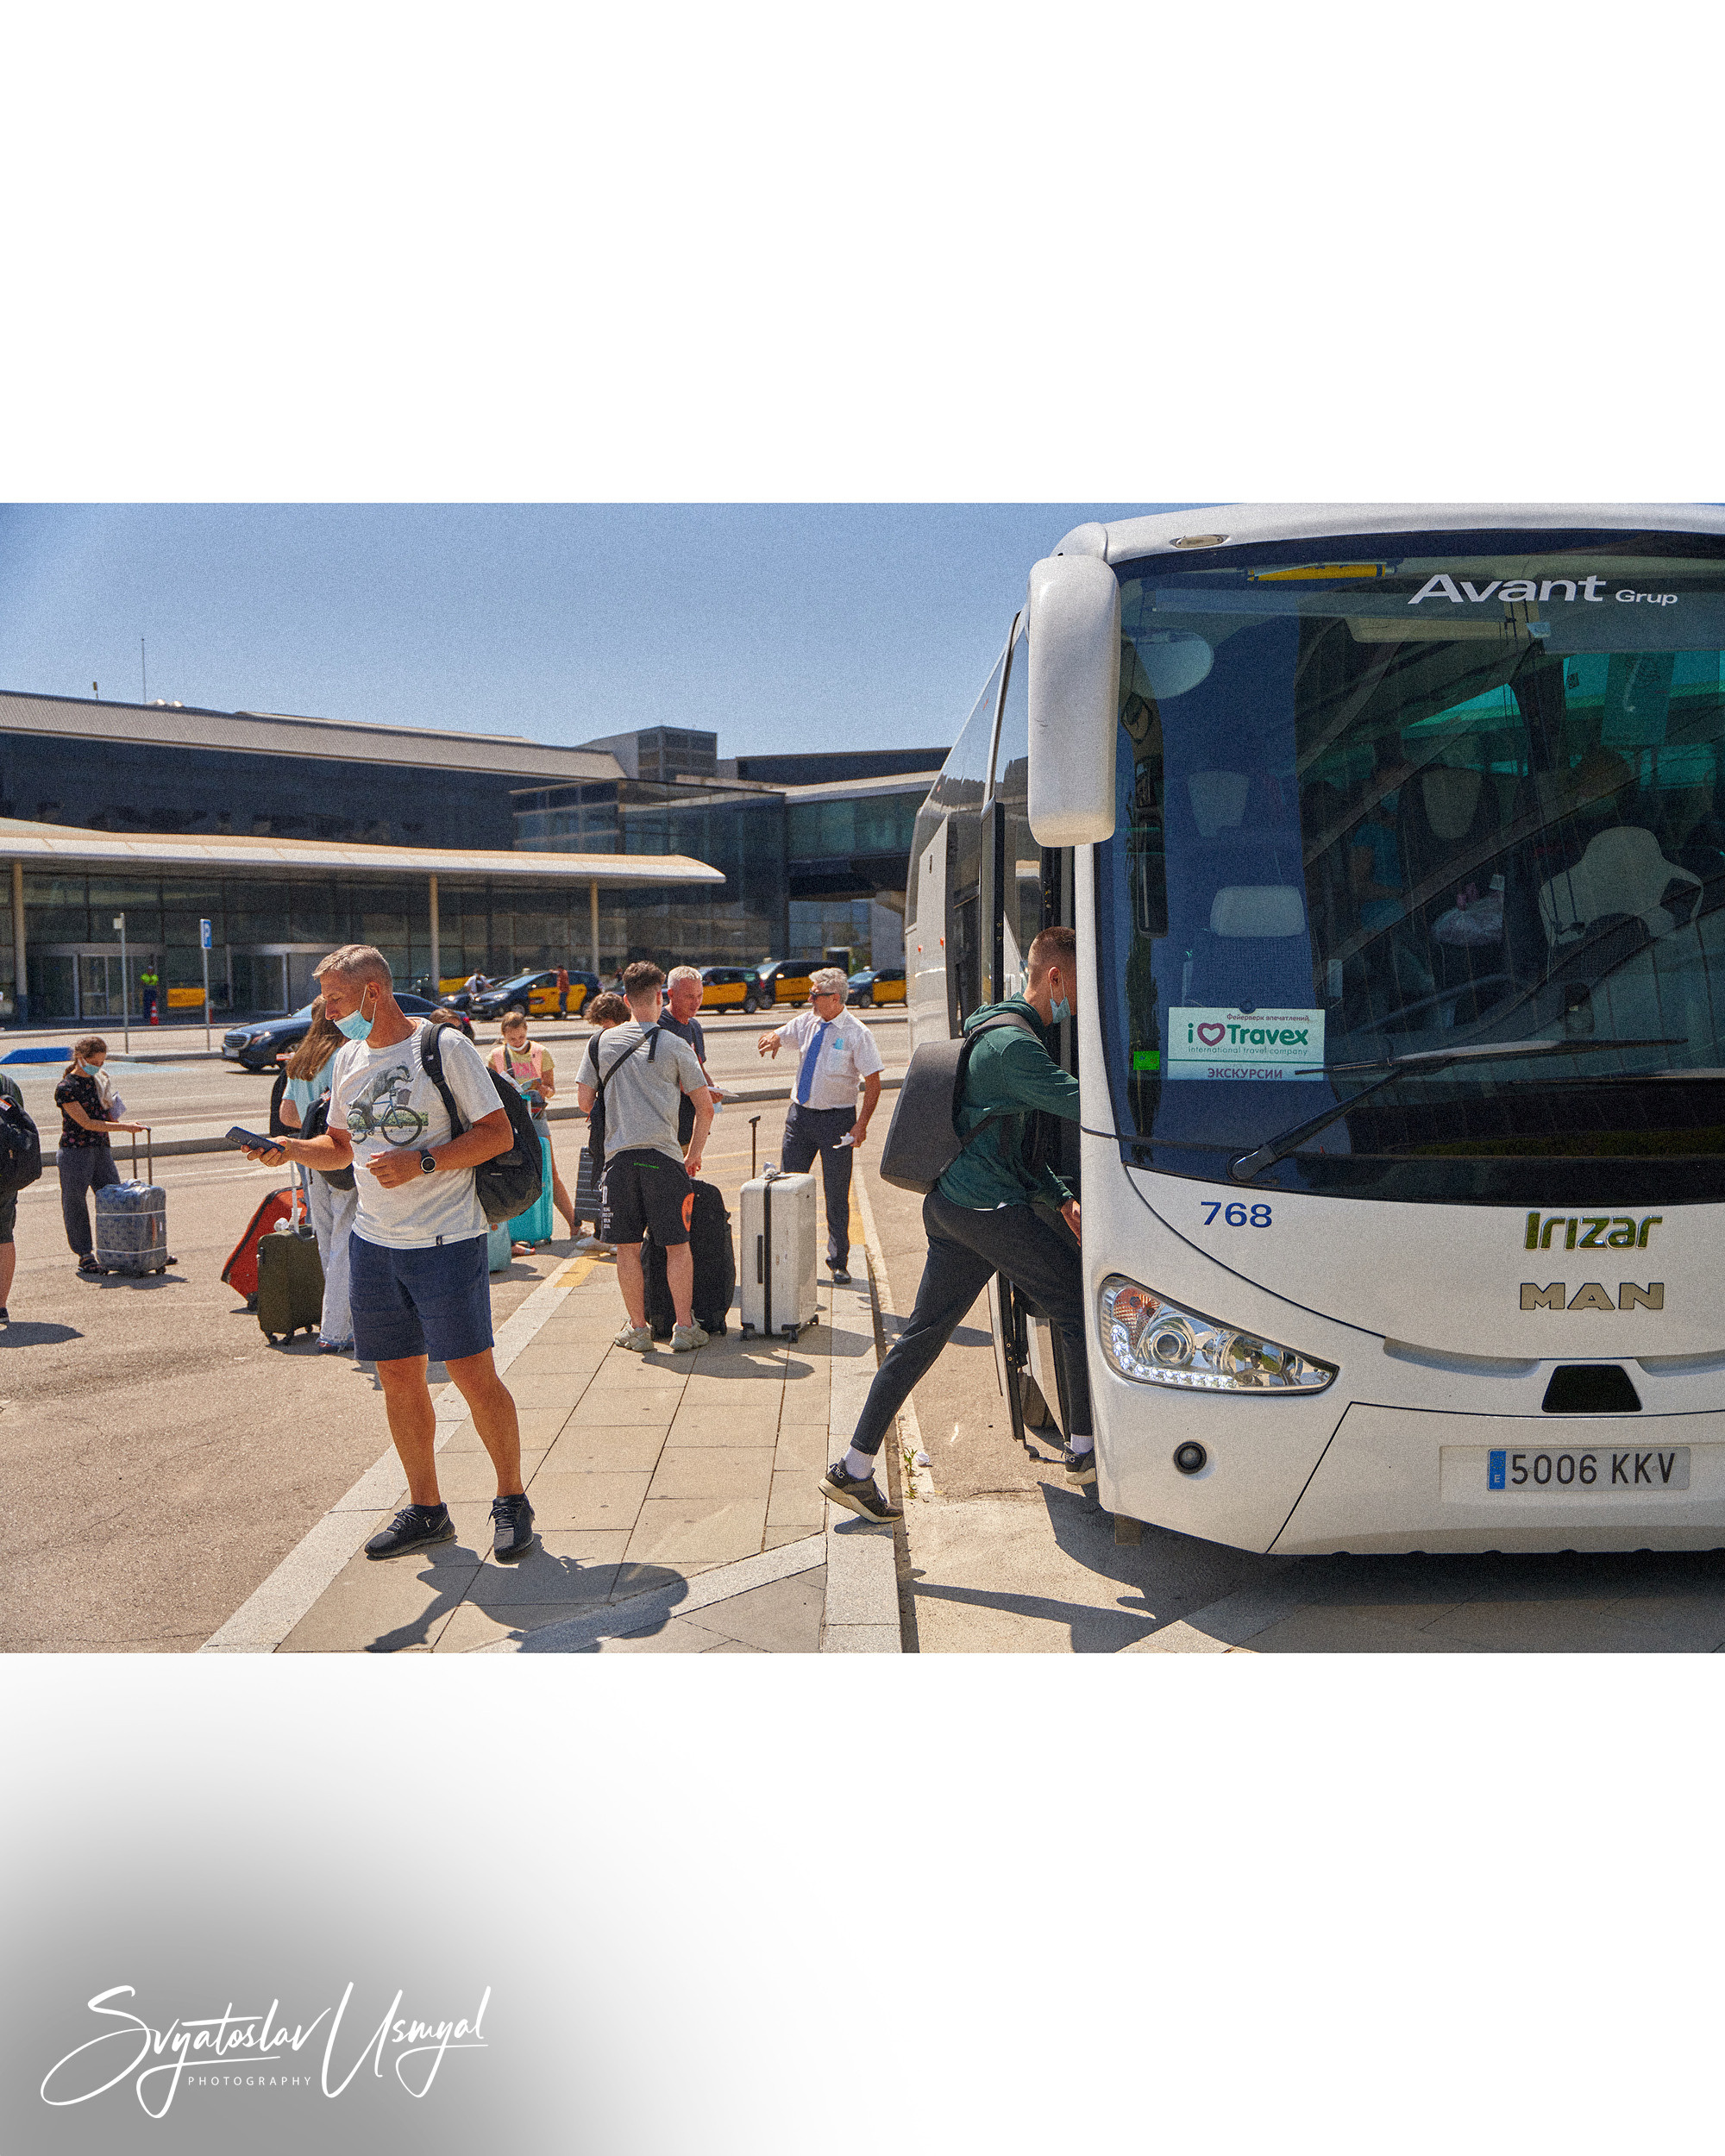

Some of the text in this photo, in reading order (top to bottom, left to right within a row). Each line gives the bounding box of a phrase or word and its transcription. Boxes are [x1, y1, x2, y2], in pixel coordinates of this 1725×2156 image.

[1408, 573, 1678, 606] Avant Grup
[1226, 1012, 1264, 1022] Фейерверк
[1188, 1023, 1308, 1046] i Travex
[1270, 1047, 1308, 1056] company
[1207, 1068, 1283, 1079] ЭКСКУРСИИ
[1200, 1201, 1272, 1228] 768
[1523, 1210, 1663, 1250] Irizar
[1520, 1282, 1665, 1310] MAN
[1494, 1452, 1675, 1485] E 5006 KKV
